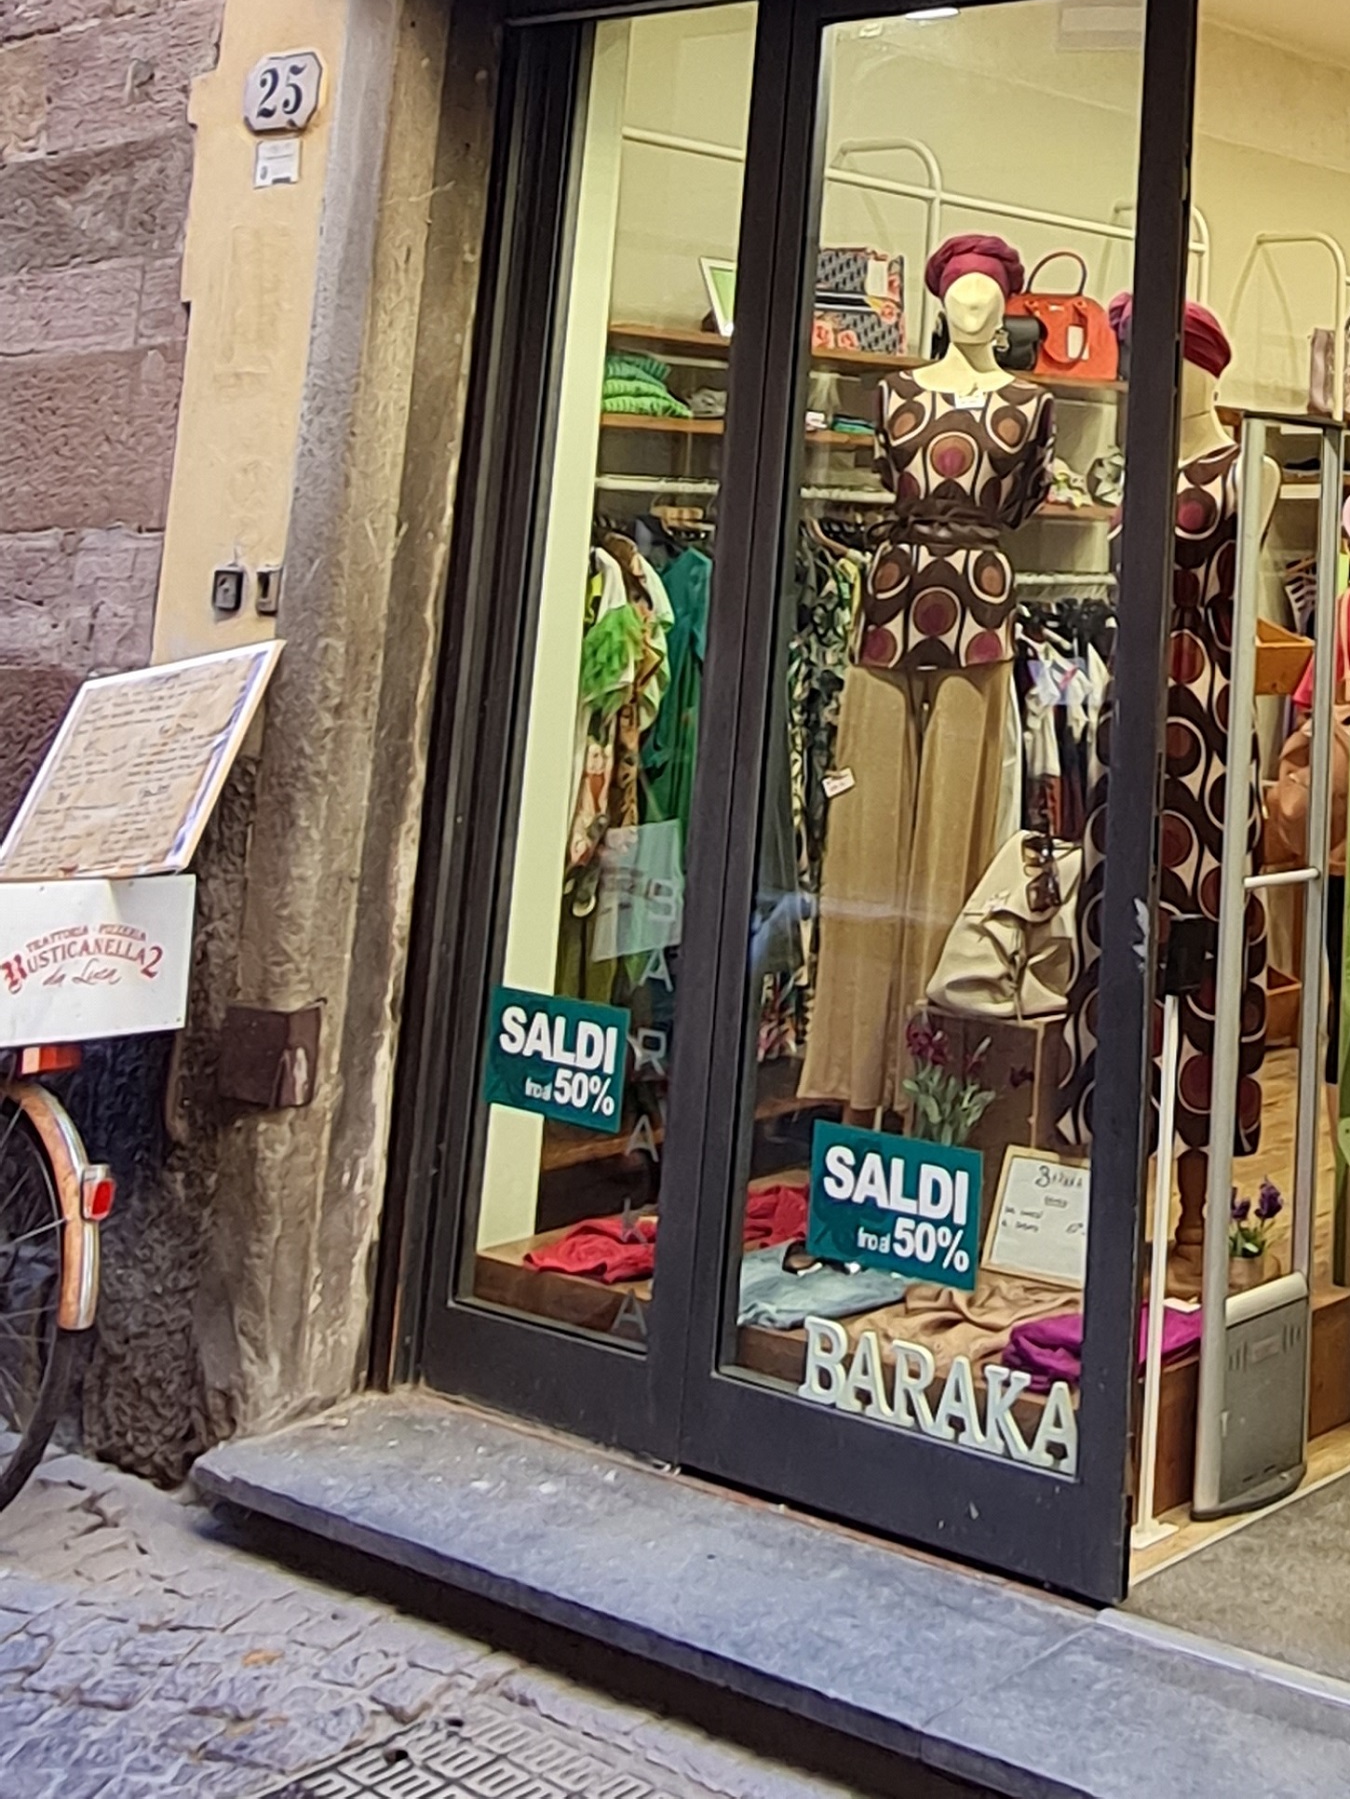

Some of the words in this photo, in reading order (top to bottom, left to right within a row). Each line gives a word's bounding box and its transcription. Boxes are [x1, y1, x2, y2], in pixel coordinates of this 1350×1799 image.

[256, 64, 308, 119] 25
[25, 925, 89, 953] TRATTORIA
[98, 924, 147, 941] PIZZERIA
[0, 939, 146, 995] RUSTICANELLA
[140, 946, 163, 979] 2
[499, 1005, 618, 1075] SALDI
[554, 1068, 615, 1117] 50%
[823, 1145, 969, 1226] SALDI
[893, 1217, 970, 1272] 50%
[798, 1316, 1078, 1472] BARAKA
